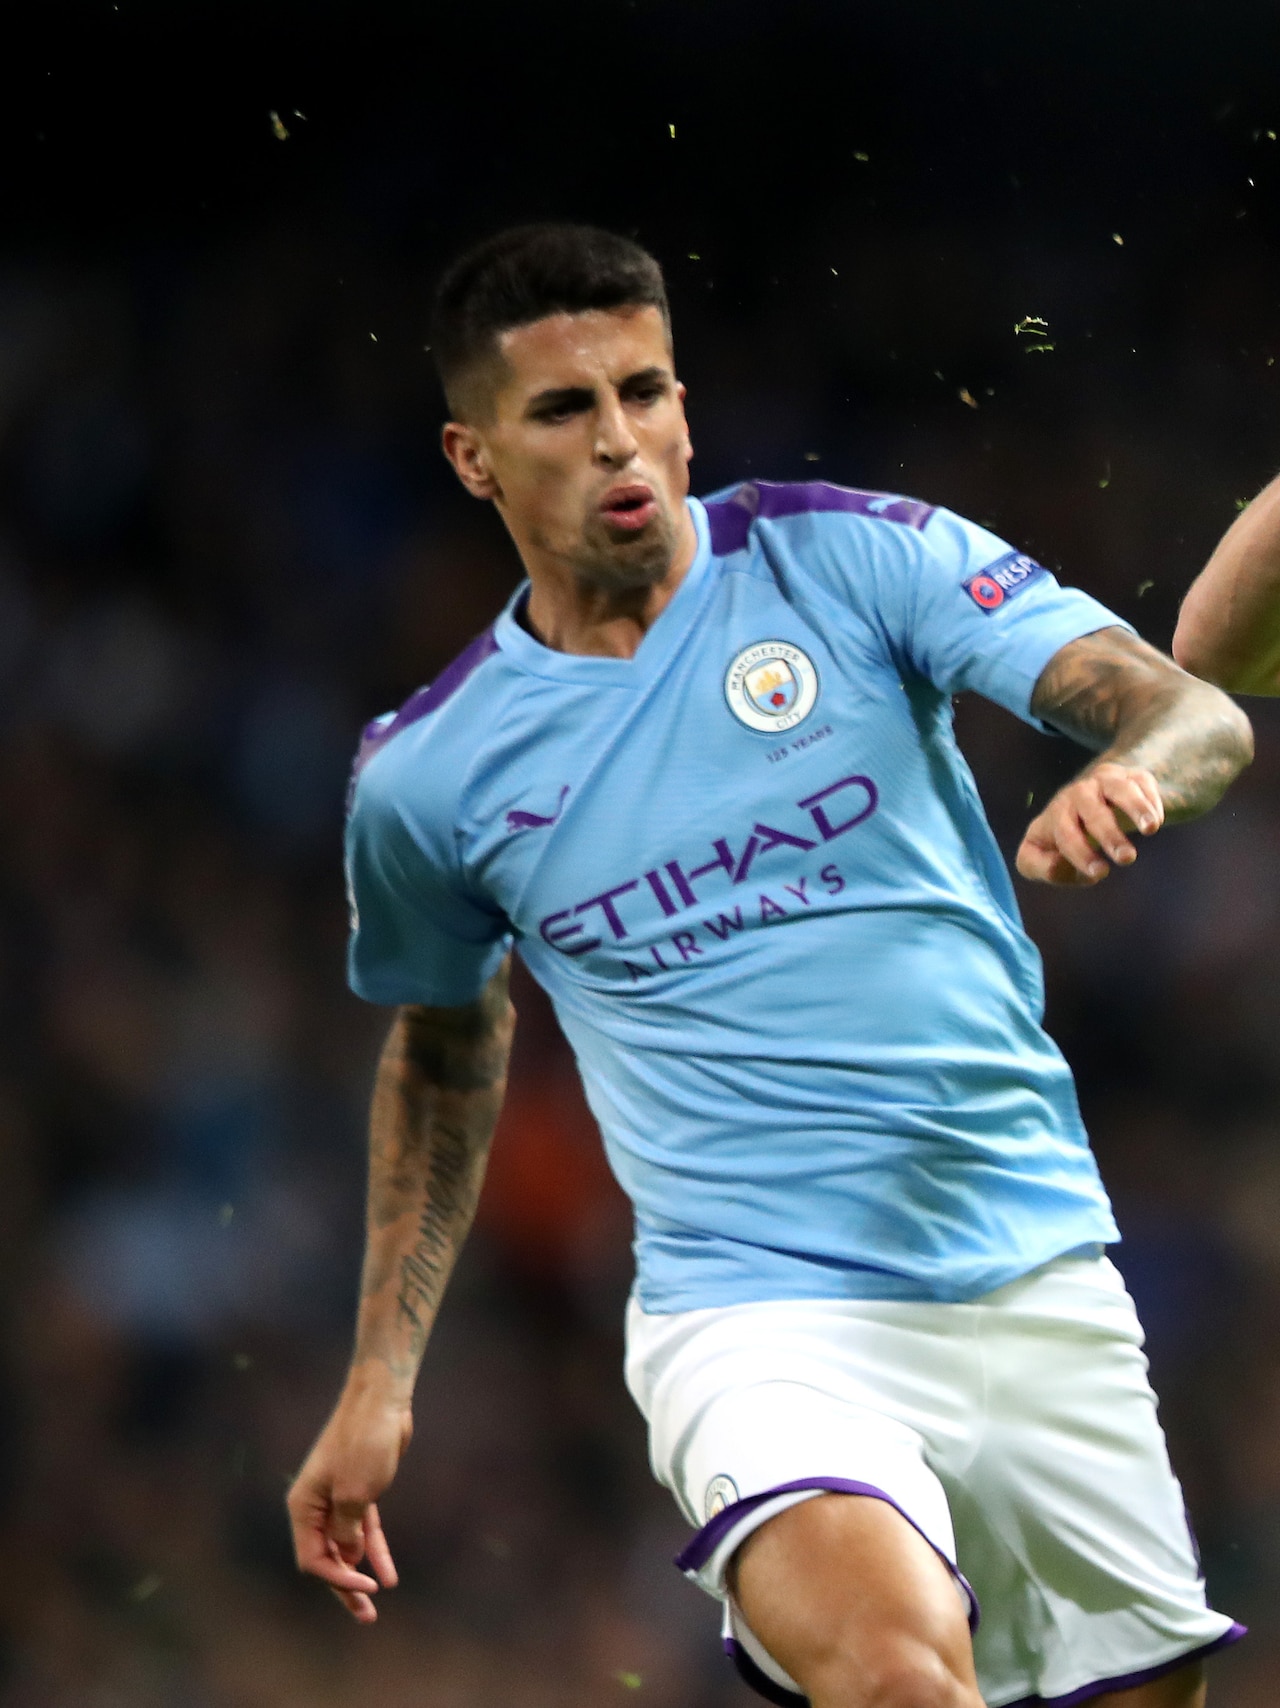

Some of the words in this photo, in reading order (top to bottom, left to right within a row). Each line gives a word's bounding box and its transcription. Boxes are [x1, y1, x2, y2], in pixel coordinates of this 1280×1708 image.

[732, 647, 799, 690] MANCHESTER
[776, 713, 800, 729] CITY
[767, 748, 788, 763] 125
[792, 725, 833, 750] YEARS
[540, 774, 879, 956] ETIHAD
[622, 863, 846, 982] AIRWAYS
